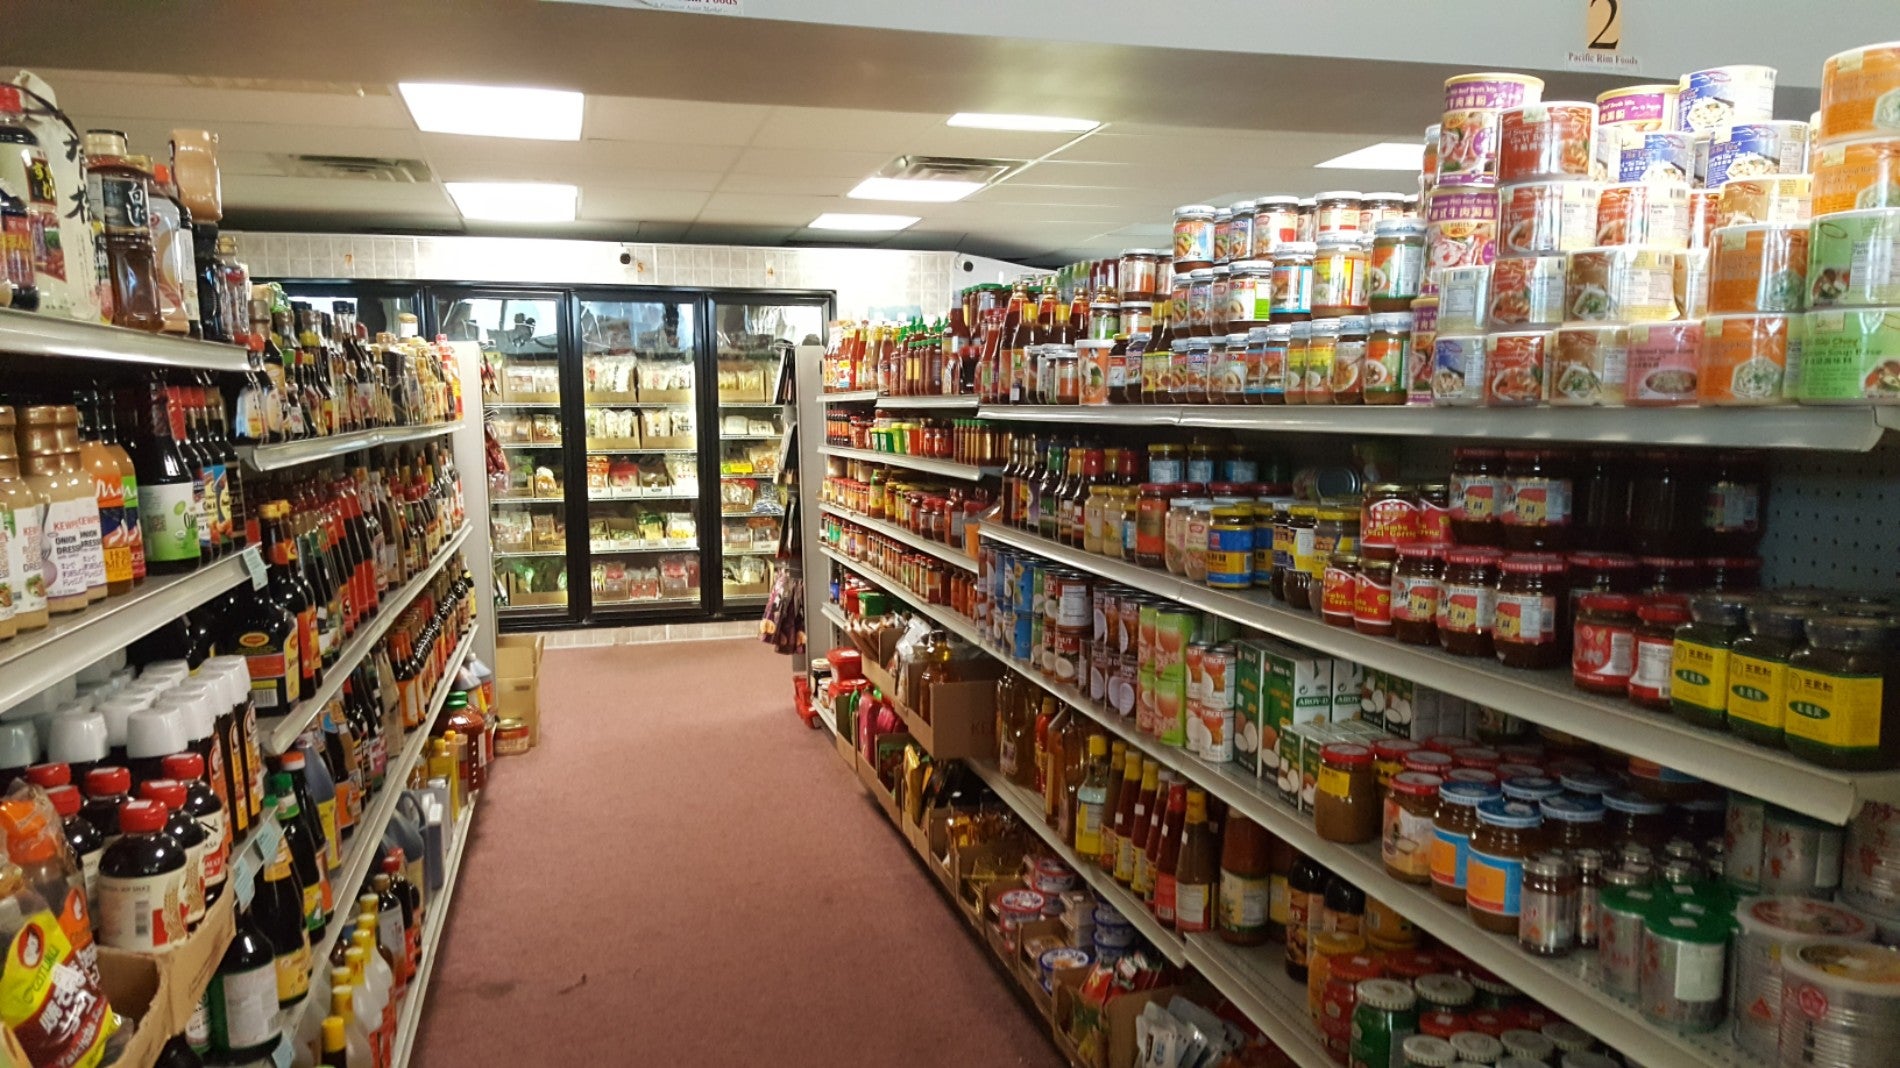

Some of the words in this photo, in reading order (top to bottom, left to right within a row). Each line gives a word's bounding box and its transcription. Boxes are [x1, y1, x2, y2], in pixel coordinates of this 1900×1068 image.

[1588, 0, 1619, 49] 2
[1568, 52, 1594, 62] Pacific
[1597, 54, 1614, 63] Rim
[1616, 55, 1638, 65] Foods
[1298, 697, 1329, 706] AROY-D
[1337, 696, 1359, 704] AROY
